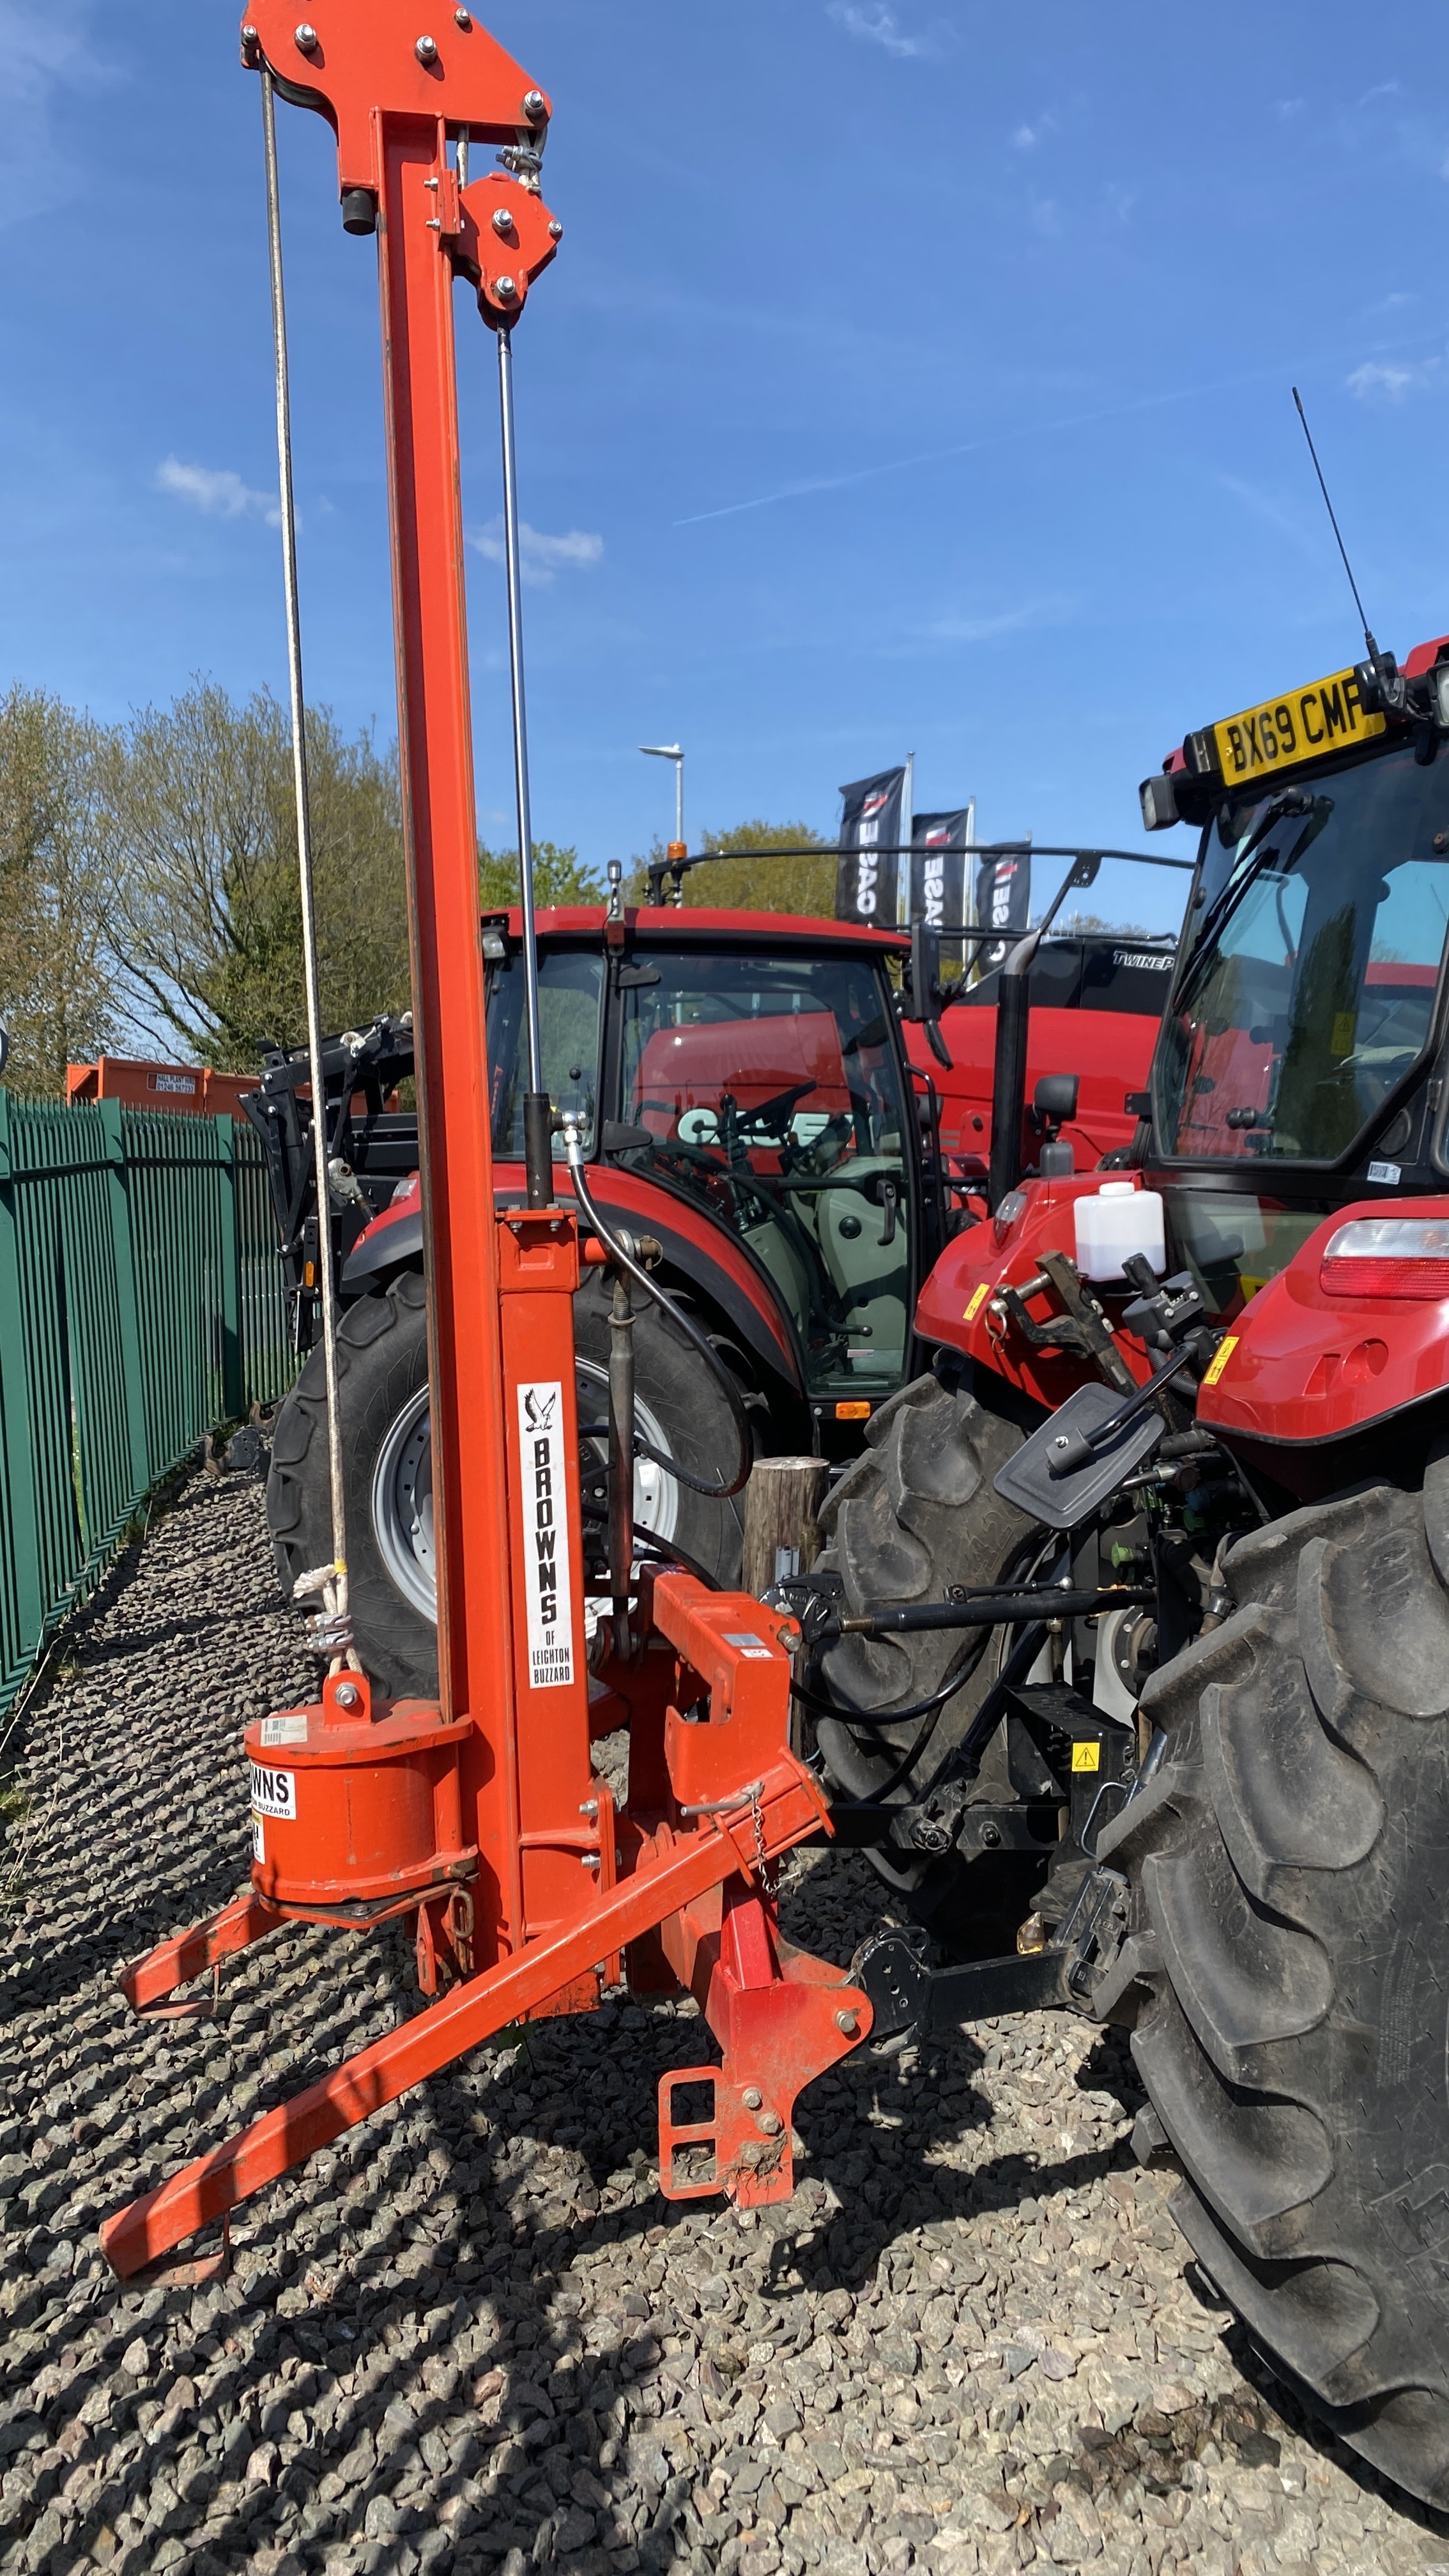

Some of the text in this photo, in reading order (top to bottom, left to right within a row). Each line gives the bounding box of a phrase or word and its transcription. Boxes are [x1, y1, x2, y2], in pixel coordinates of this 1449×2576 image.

[1227, 705, 1297, 772] BX69
[1113, 950, 1175, 971] TWINEP
[534, 1437, 557, 1625] BROWNS
[546, 1630, 555, 1646] OF
[532, 1647, 569, 1666] LEIGHTON
[534, 1666, 570, 1684] BUZZARD
[250, 1764, 289, 1804] WNS
[258, 1802, 290, 1816] BUZZARD
